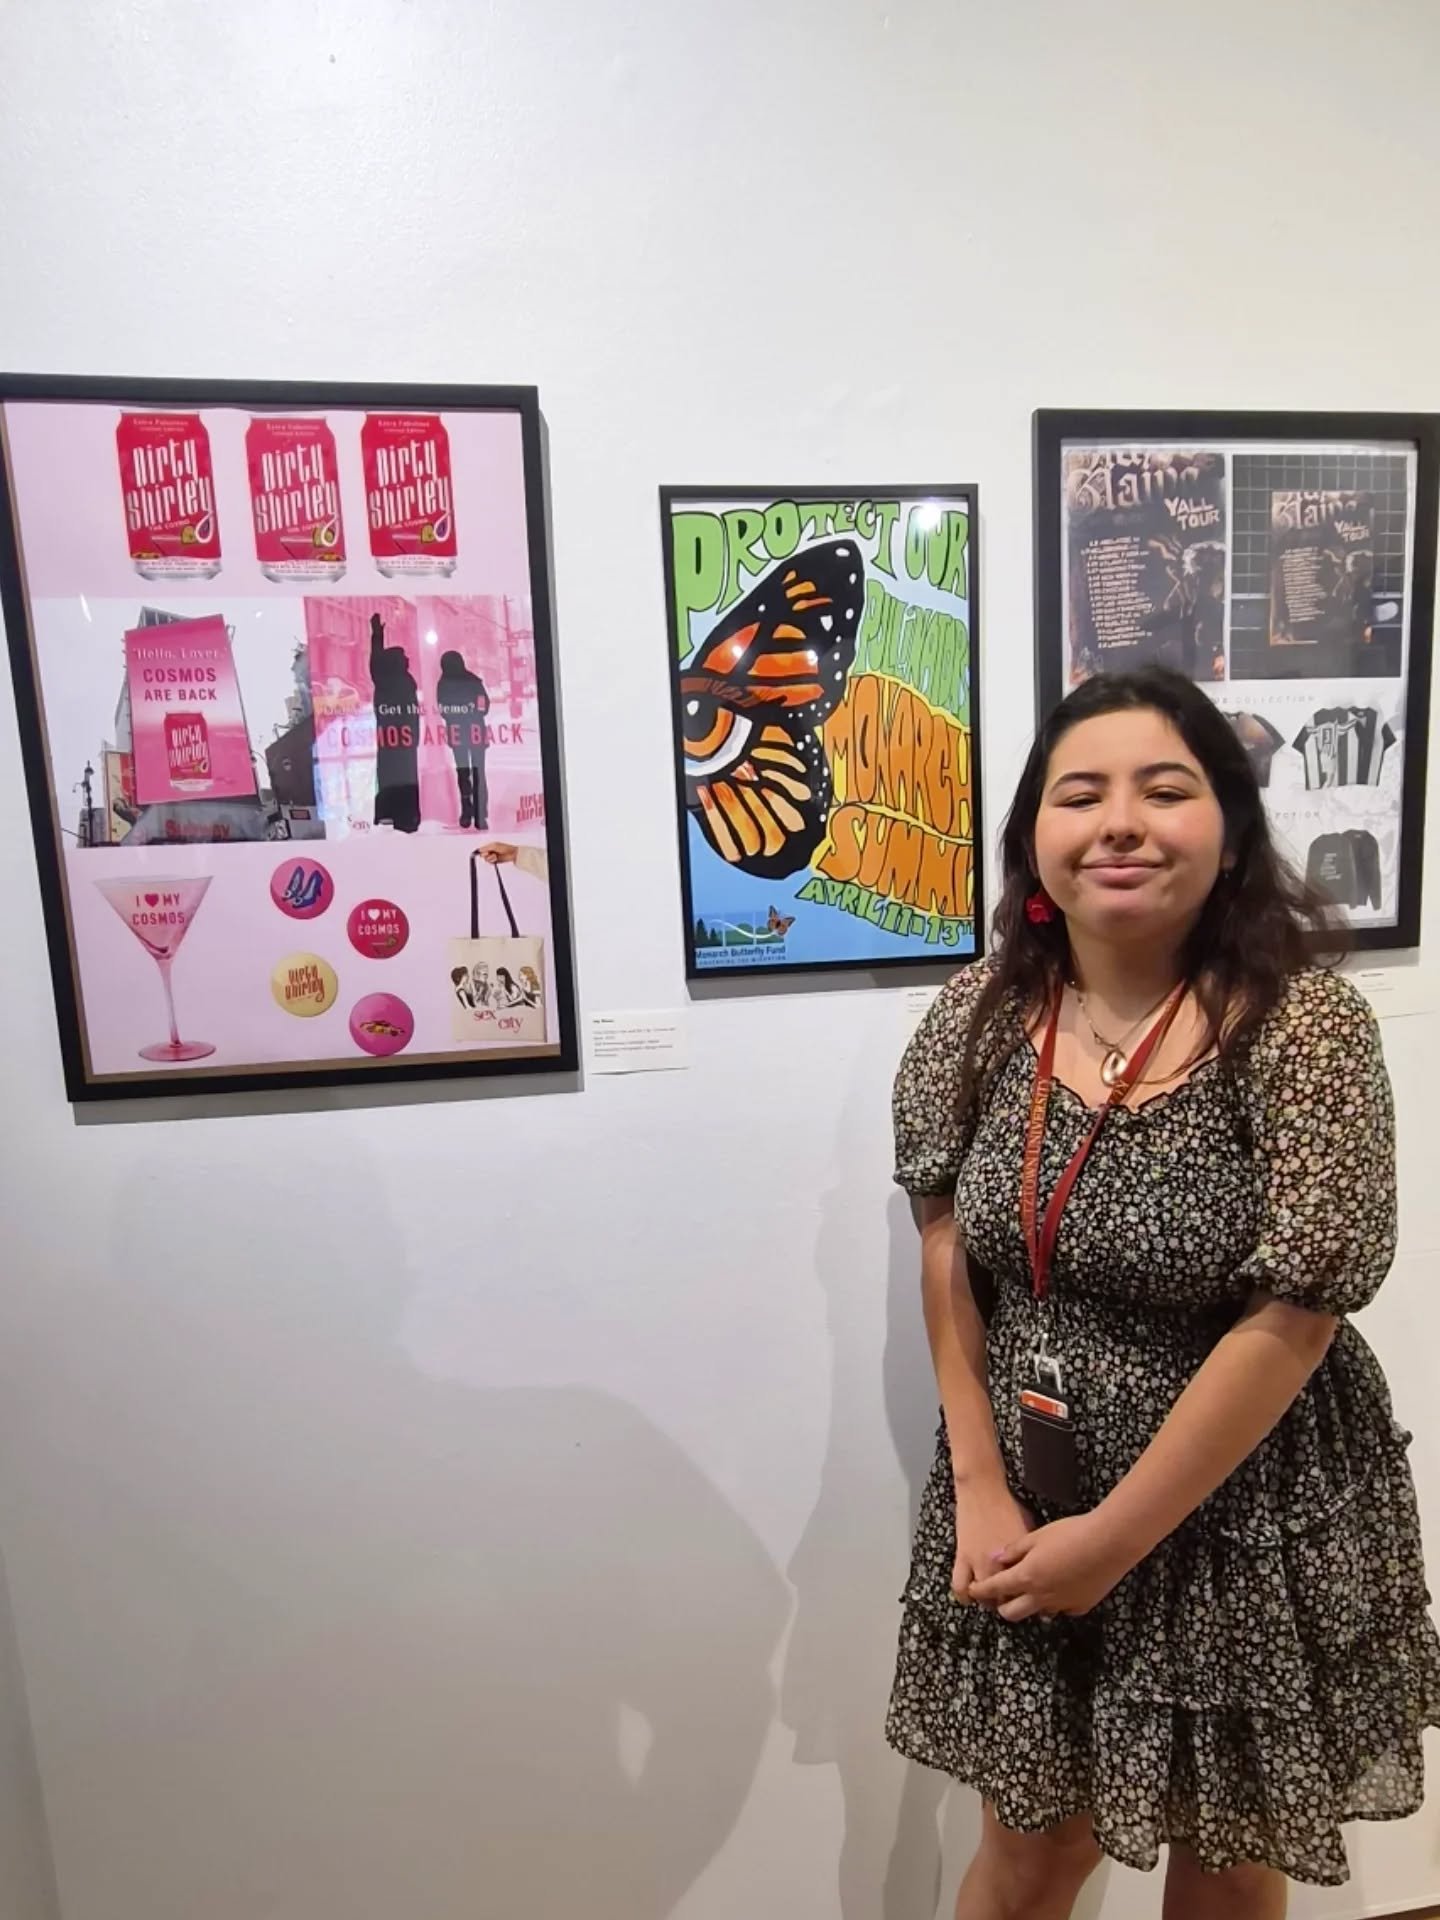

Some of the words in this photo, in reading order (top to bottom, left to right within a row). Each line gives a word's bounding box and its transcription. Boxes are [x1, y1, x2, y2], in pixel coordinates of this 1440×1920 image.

[1176, 508, 1220, 531] TOUR
[671, 499, 901, 662] PROTECT
[904, 505, 970, 601] OUR
[143, 667, 217, 684] COSMOS
[144, 688, 173, 702] ARE
[178, 687, 217, 702] BACK
[378, 703, 402, 716] Get
[423, 723, 462, 746] ARE
[470, 722, 524, 745] BACK
[823, 674, 974, 840] MONARCH
[136, 895, 140, 908] I
[162, 892, 180, 907] MY
[794, 876, 884, 927] APRIL
[132, 911, 185, 926] COSMOS
[360, 909, 366, 921] I
[382, 908, 397, 921] MY
[358, 923, 401, 936] COSMOS
[766, 944, 786, 955] Fund
[1028, 1078, 1049, 1153] UNIVERSITY
